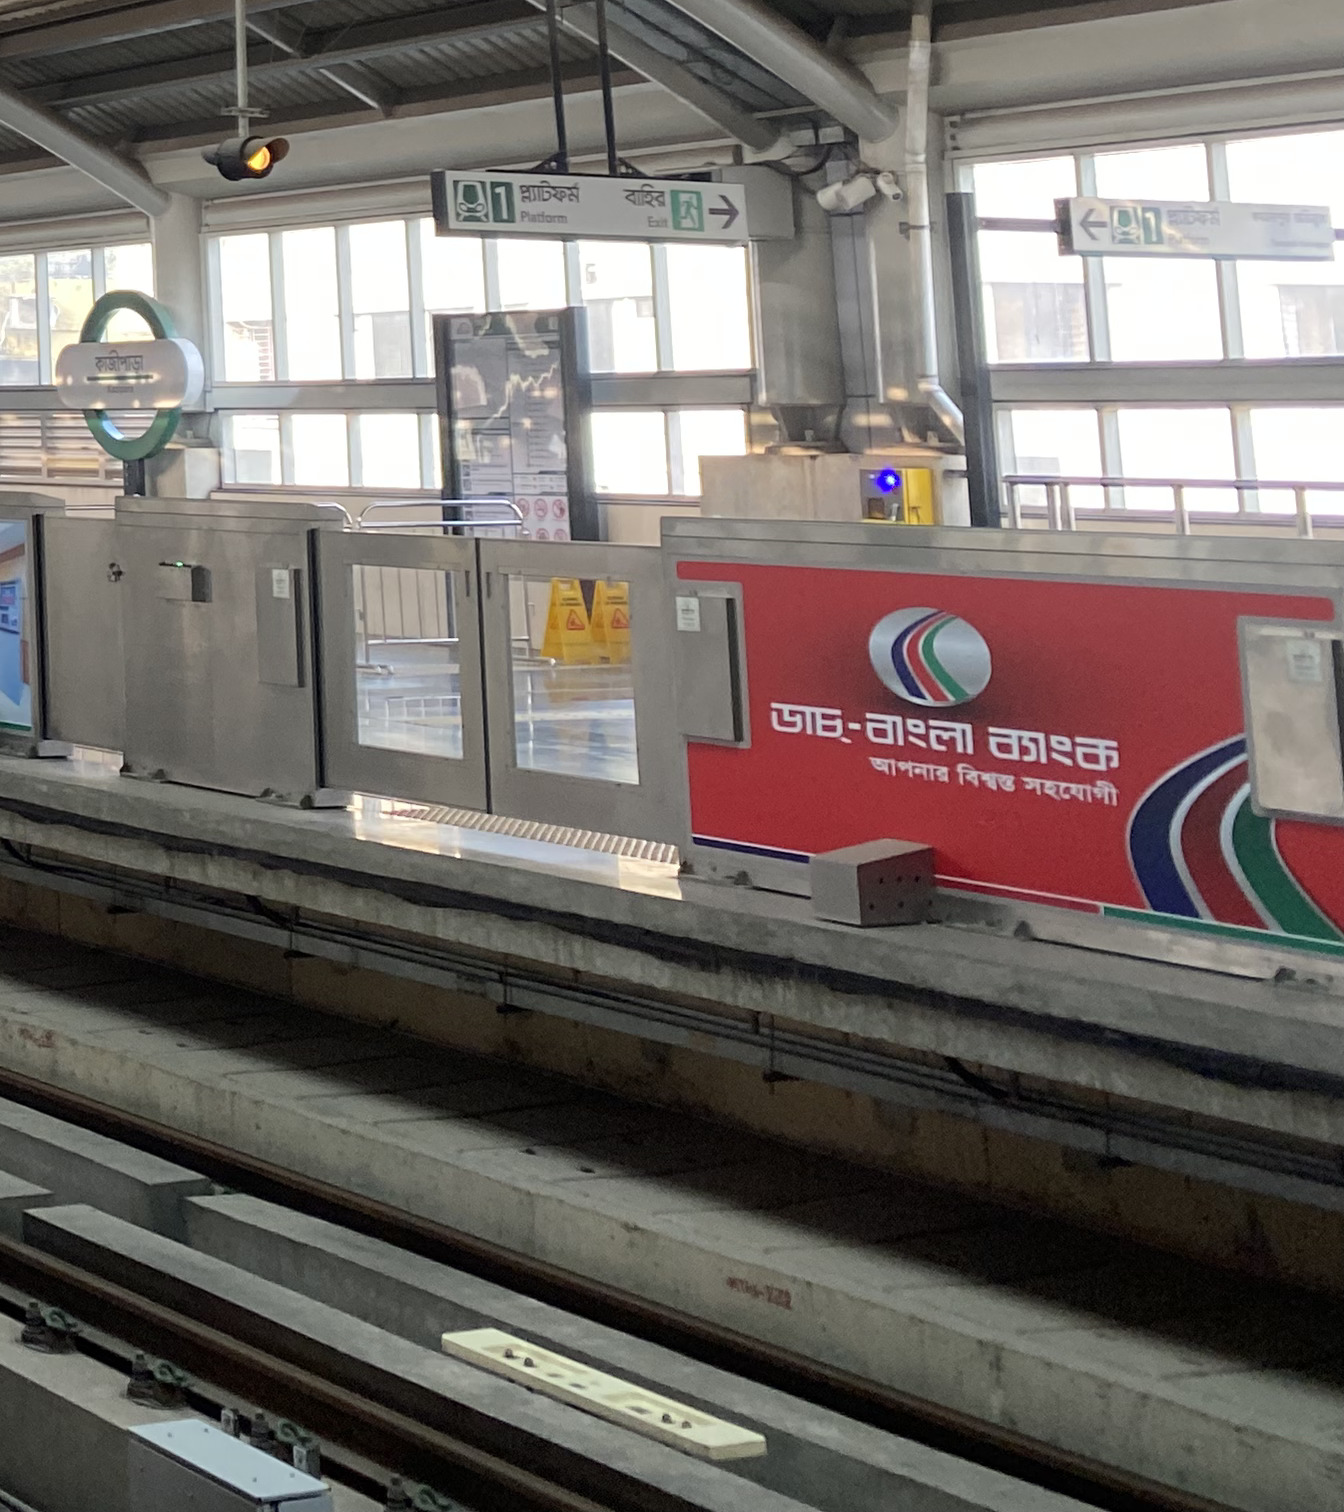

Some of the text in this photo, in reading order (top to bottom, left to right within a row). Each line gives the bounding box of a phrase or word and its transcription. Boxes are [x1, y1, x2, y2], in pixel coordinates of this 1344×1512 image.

[495, 179, 580, 220] 1 প্ল্যাটফর্ম
[623, 183, 665, 208] বাহির
[520, 210, 568, 224] Platform
[647, 215, 668, 228] Exit
[1144, 211, 1157, 243] 1
[95, 350, 144, 374] কাজীপাড়া
[770, 702, 1120, 772] ডাচ্-বাংলা ব্যাংক
[868, 756, 949, 783] আপনার
[1021, 776, 1120, 807] সহযোগী
